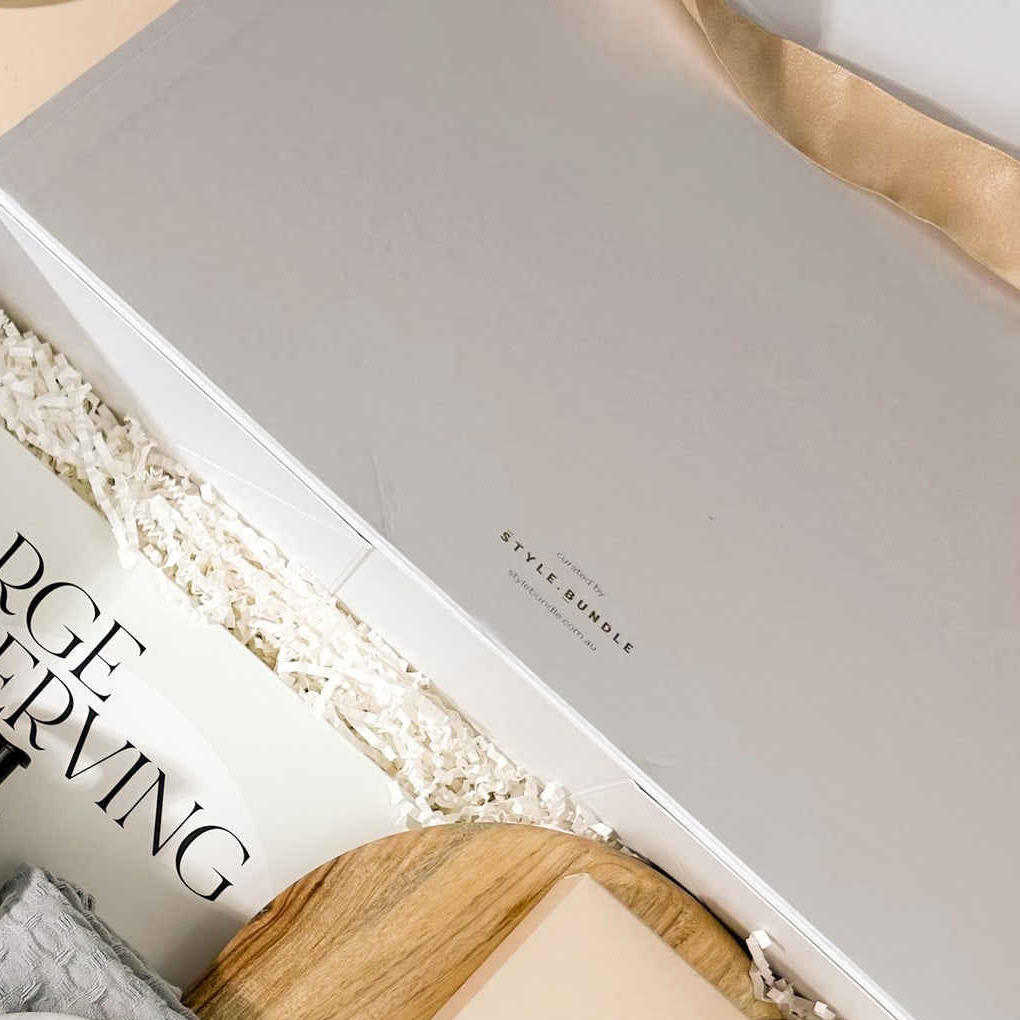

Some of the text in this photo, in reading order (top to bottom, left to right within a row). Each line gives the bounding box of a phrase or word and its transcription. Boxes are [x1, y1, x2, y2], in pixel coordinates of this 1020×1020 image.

[500, 529, 634, 654] STYLE.BUNDLE
[507, 569, 598, 652] stylebundle.com.au
[556, 552, 607, 598] curated by
